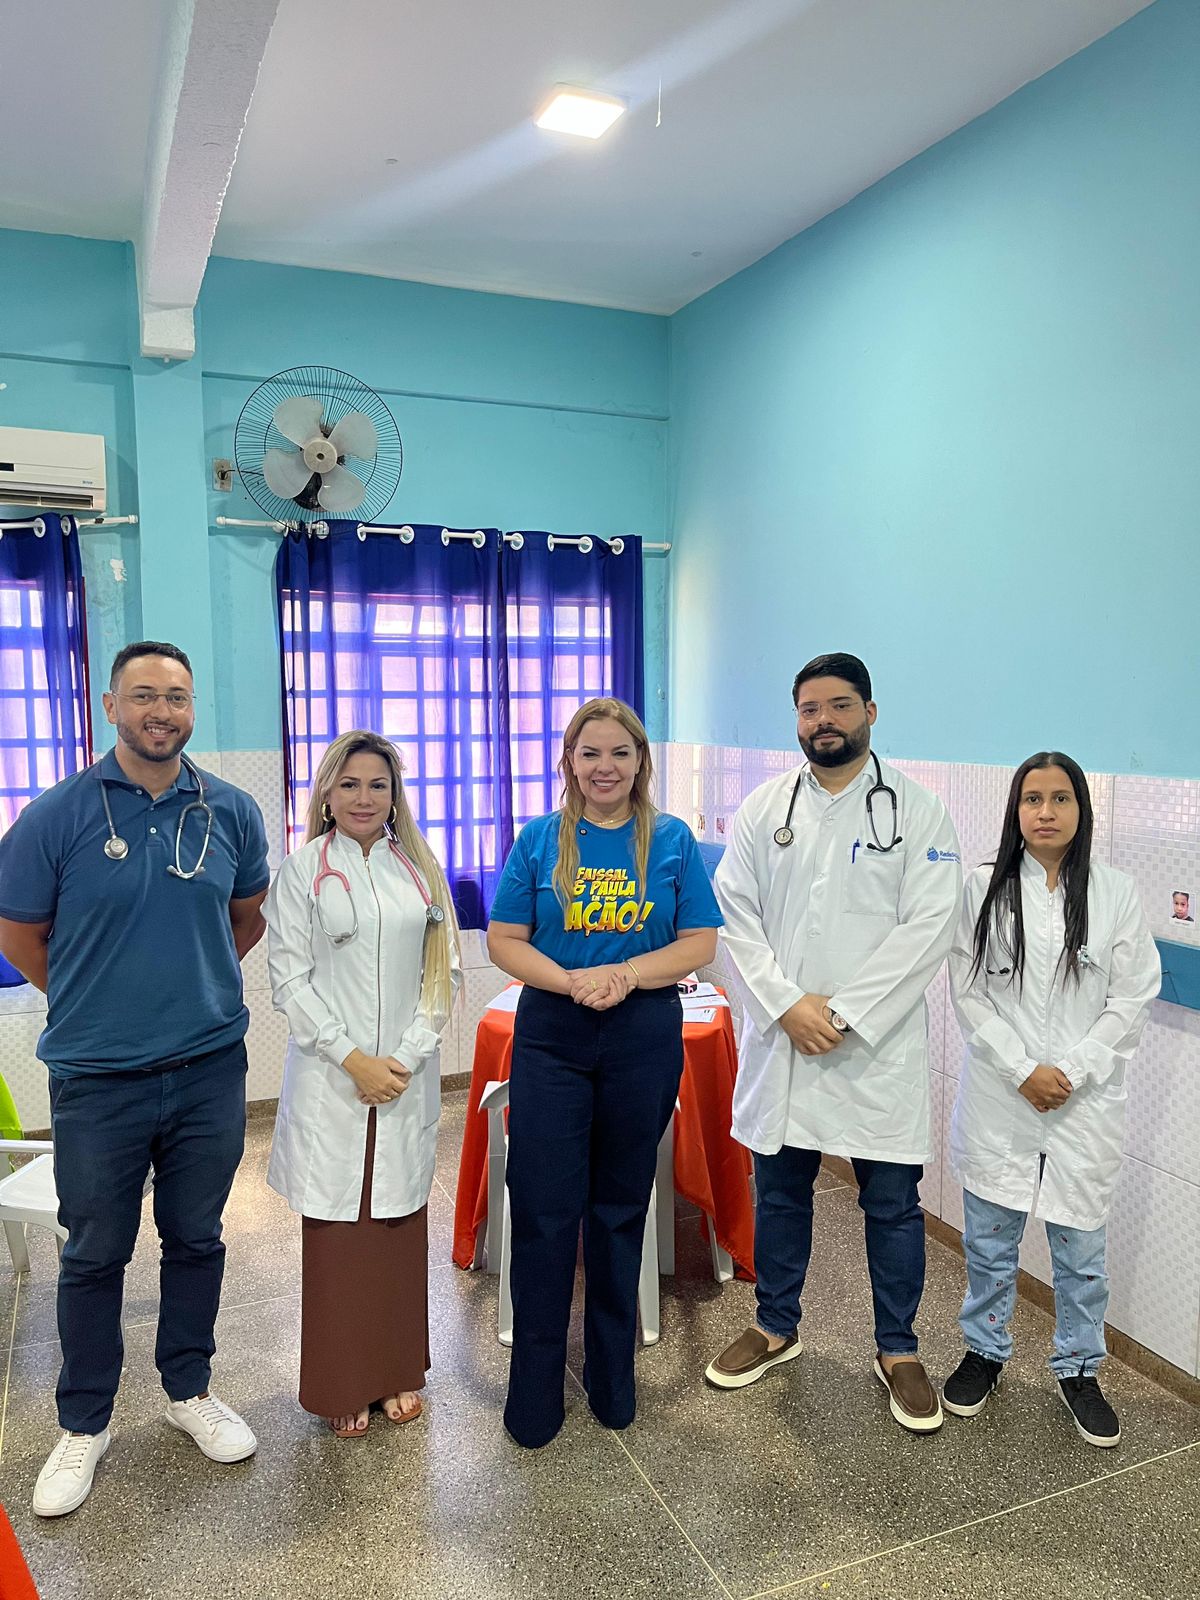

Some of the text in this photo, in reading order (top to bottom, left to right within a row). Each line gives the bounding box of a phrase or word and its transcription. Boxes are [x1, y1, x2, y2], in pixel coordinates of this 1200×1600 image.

[576, 867, 628, 880] FAISSAL
[589, 880, 636, 896] PAULA
[564, 894, 655, 937] AÇÃO!
